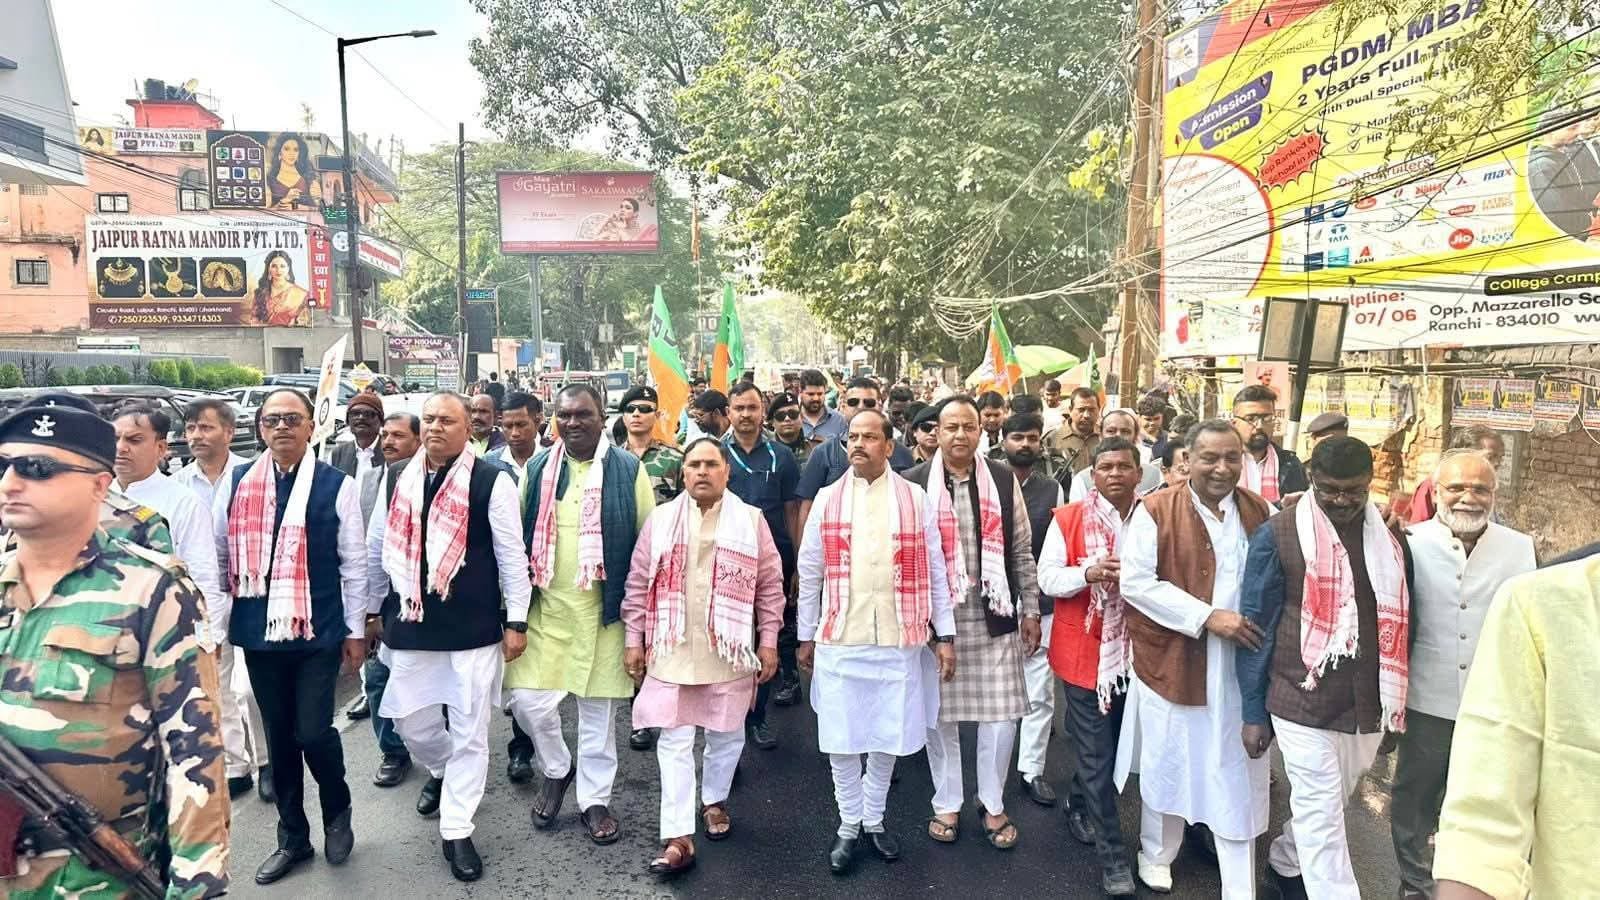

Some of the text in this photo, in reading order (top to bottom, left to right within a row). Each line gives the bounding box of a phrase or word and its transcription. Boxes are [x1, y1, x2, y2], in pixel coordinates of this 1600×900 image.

[1298, 93, 1308, 107] 2
[1314, 71, 1371, 101] Years
[1378, 49, 1419, 77] Full
[1346, 89, 1374, 108] Dual
[1212, 114, 1251, 142] Open
[1366, 133, 1384, 144] HR
[1483, 168, 1512, 181] max
[523, 179, 576, 194] Gayatri
[92, 229, 303, 253] JAIPUR RATNA MANDIR PVT. LTD.
[1328, 234, 1350, 244] TATA
[1391, 308, 1417, 322] 06
[1430, 304, 1468, 319] Opp.
[1472, 293, 1574, 313] Mazzarello
[1429, 316, 1481, 332] Ranchi
[1496, 311, 1560, 328] 834010
